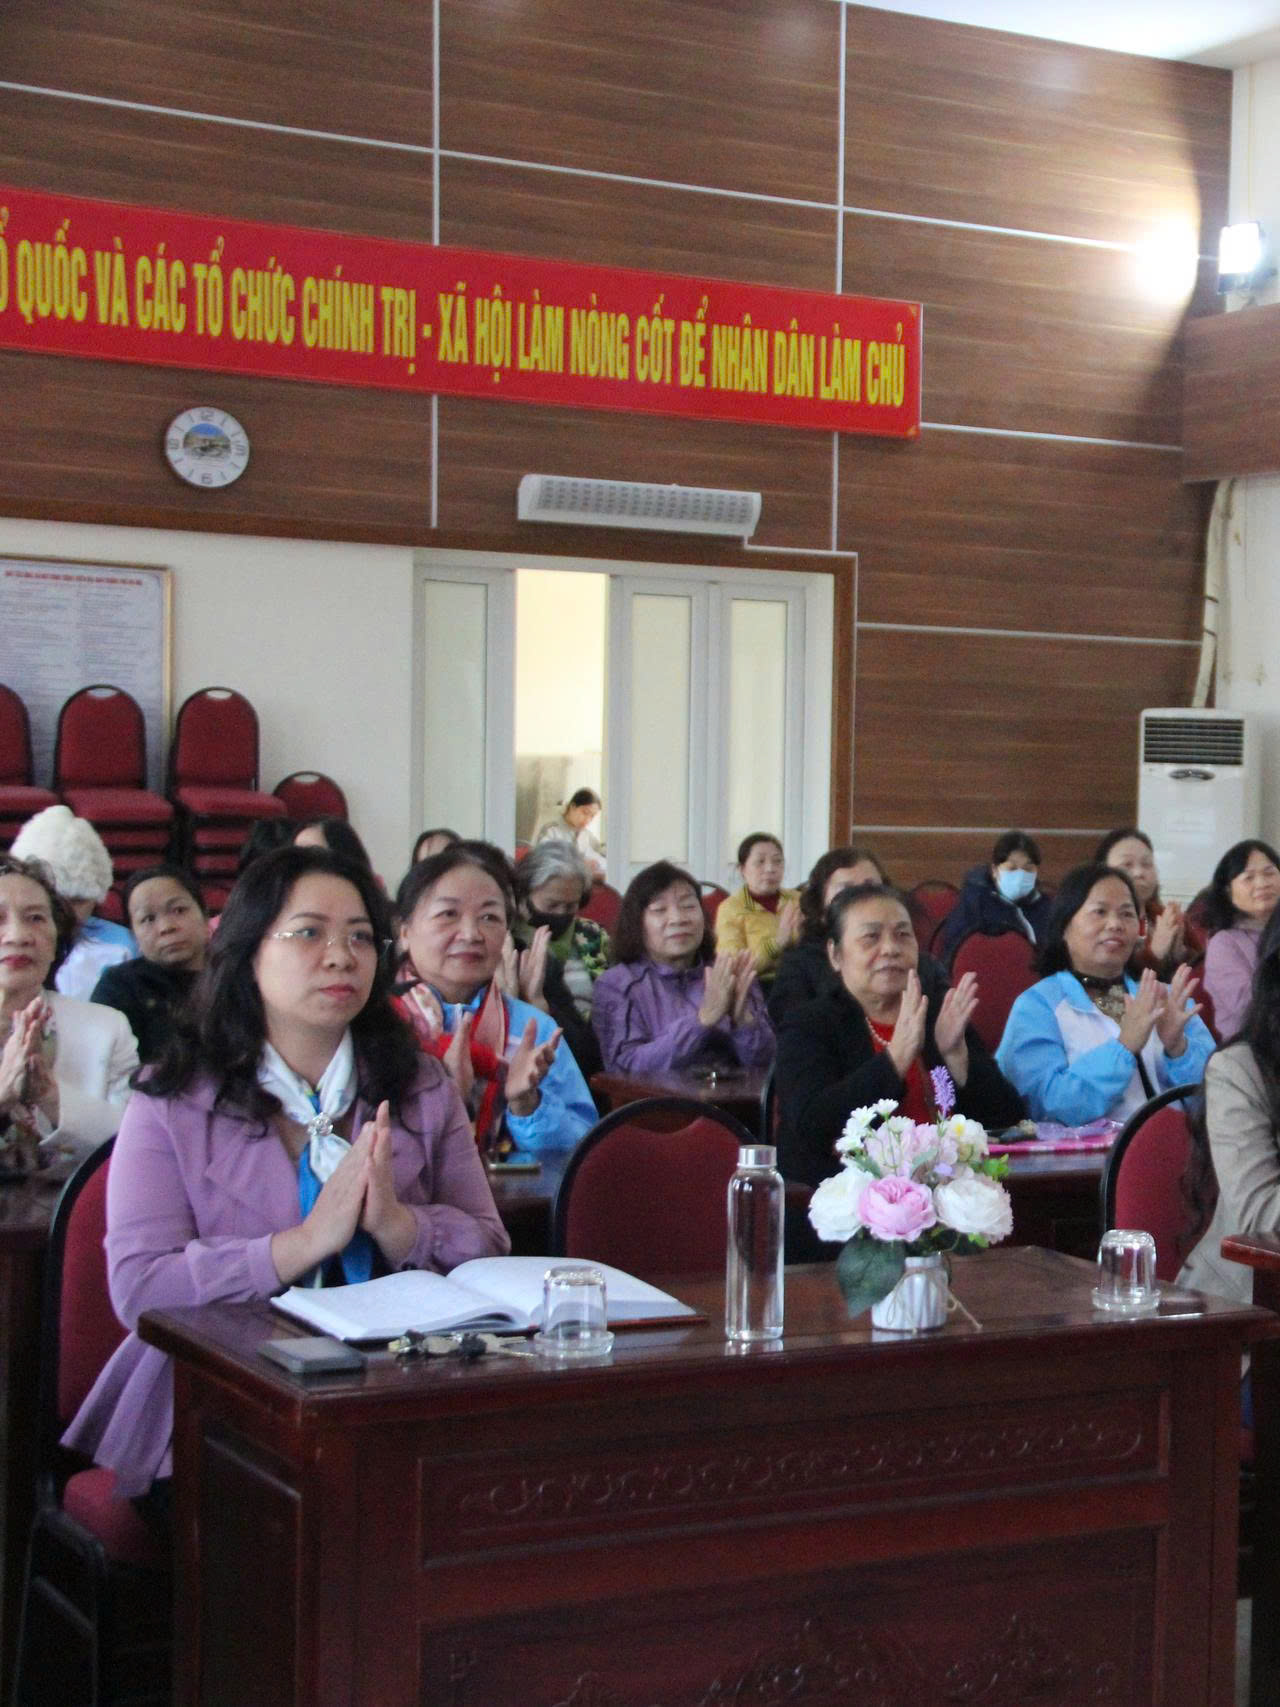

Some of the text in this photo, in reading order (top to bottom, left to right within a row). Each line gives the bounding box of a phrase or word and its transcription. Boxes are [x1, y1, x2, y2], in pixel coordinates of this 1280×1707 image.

[16, 218, 88, 324] QUỐC
[94, 236, 129, 327] VÀ
[135, 243, 187, 333] CÁC
[192, 236, 225, 337] TỔ
[230, 256, 295, 345] CHỨC
[301, 265, 375, 353] CHÍNH
[380, 286, 417, 375] TRỊ
[437, 282, 469, 364] XÃ
[474, 284, 512, 383] HỘI
[517, 289, 565, 373] LÀM
[569, 293, 630, 381] NÒNG
[635, 293, 676, 385] CỐT
[678, 295, 709, 388] ĐỂ
[711, 313, 769, 393] NHÂN
[772, 318, 815, 398] DÂN
[819, 322, 862, 403] LÀM
[865, 321, 906, 408] CHỦ
